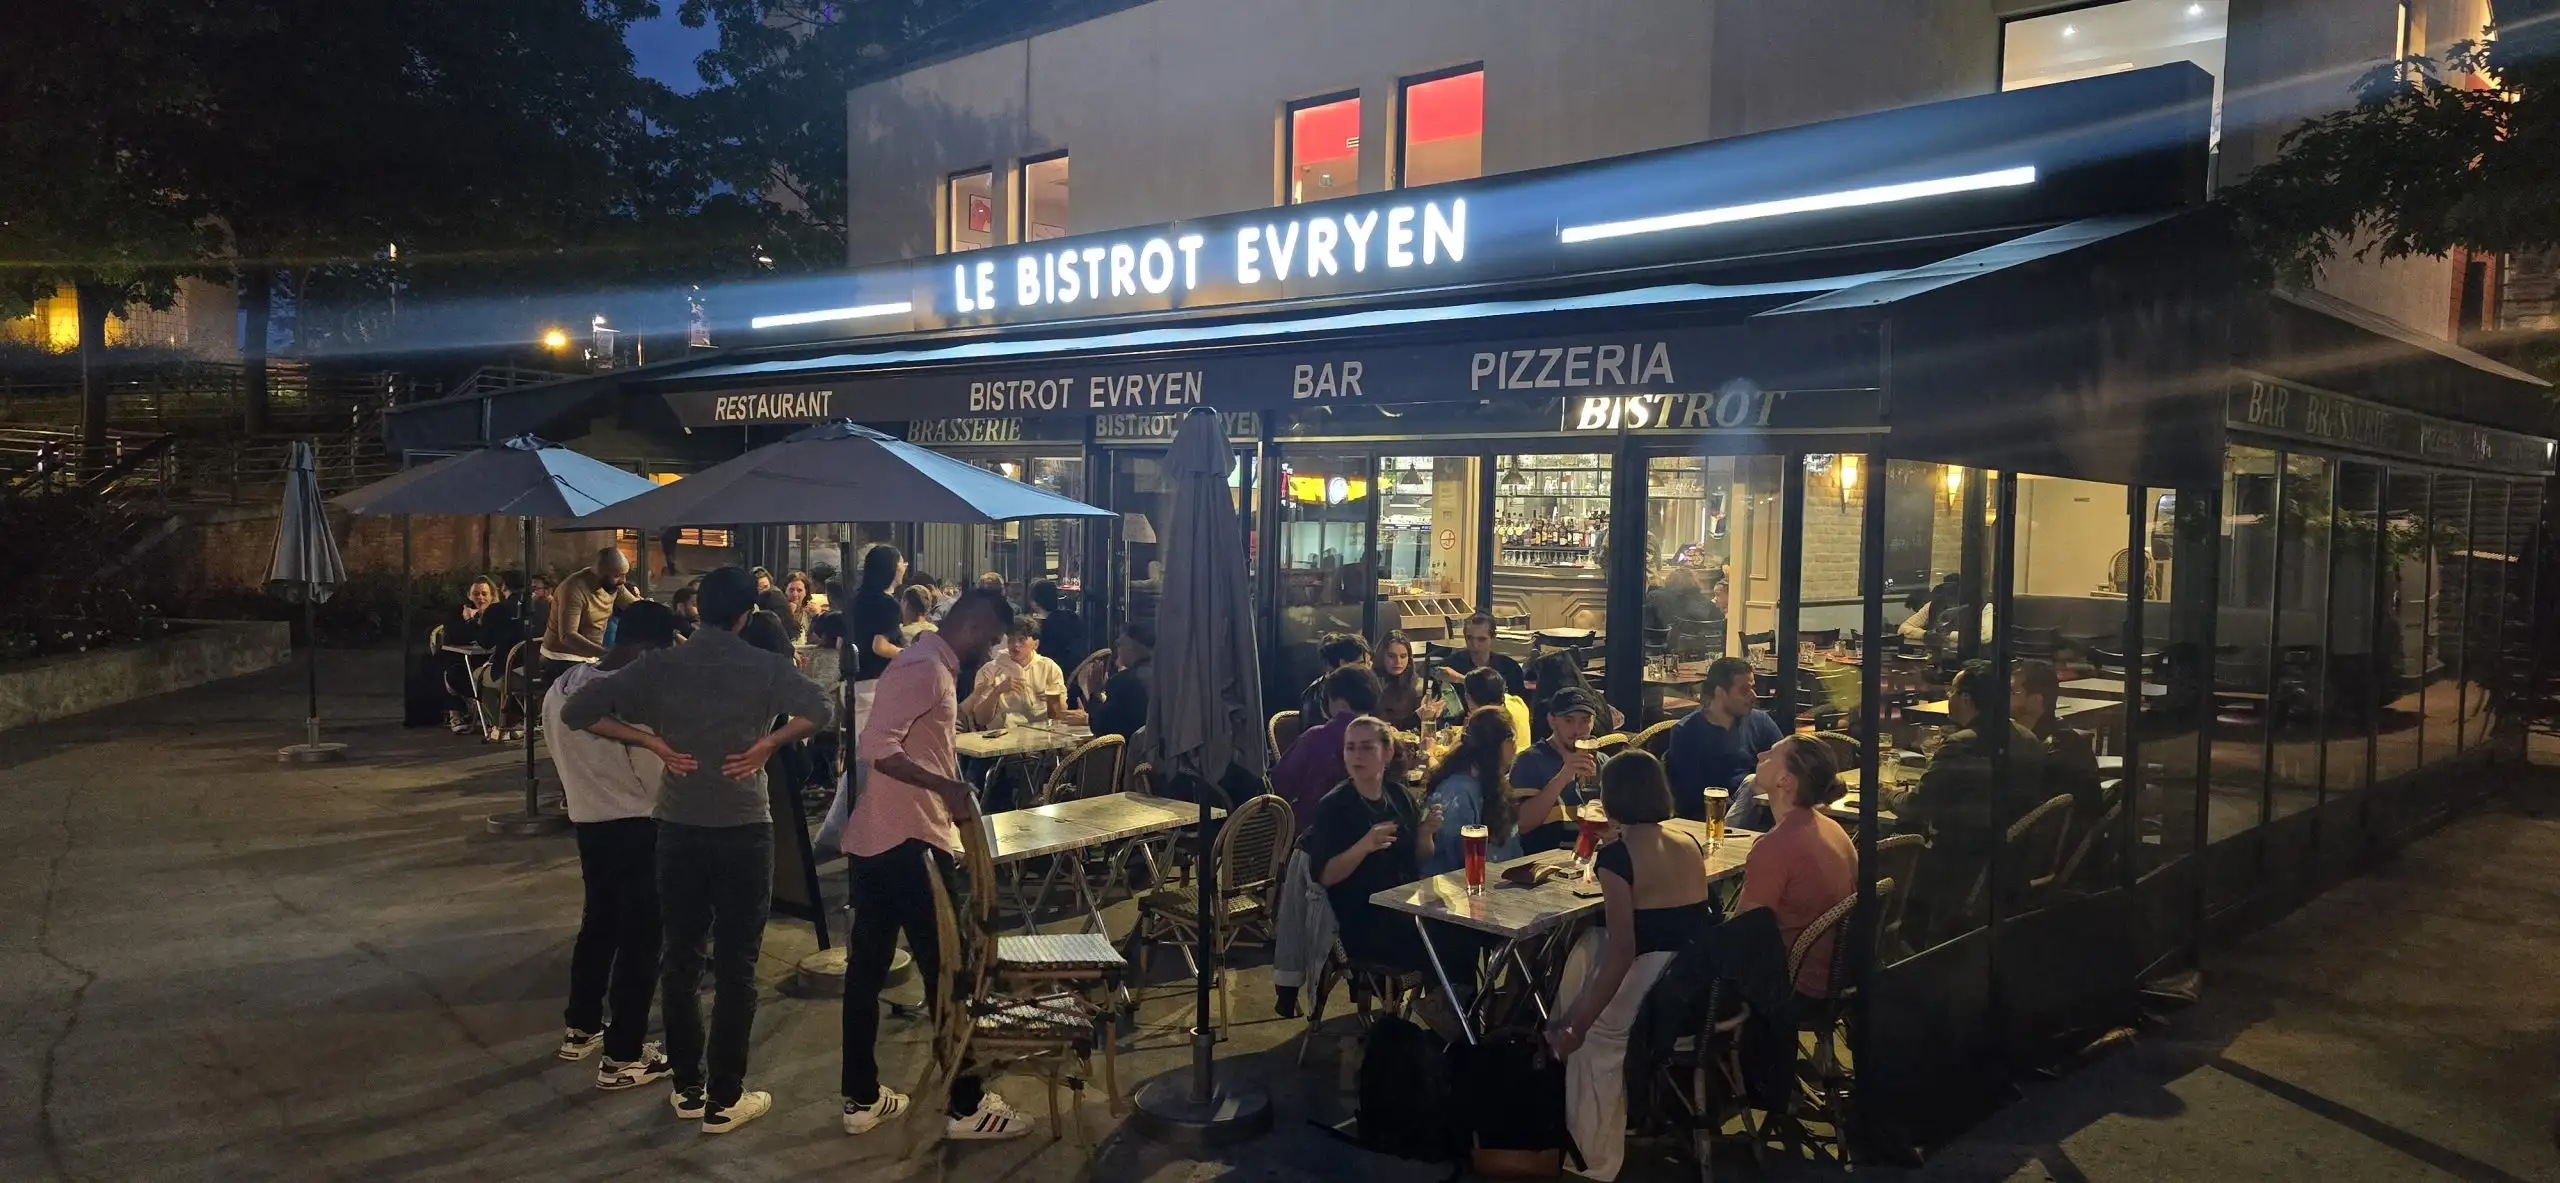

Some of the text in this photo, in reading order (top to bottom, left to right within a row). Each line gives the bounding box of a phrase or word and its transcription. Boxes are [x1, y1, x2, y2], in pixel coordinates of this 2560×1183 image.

[955, 198, 1466, 313] LE BISTROT EVRYEN
[1293, 361, 1363, 399] BAR
[1471, 341, 1674, 391] PIZZERIA
[715, 390, 833, 421] RESTAURANT
[969, 371, 1203, 411] BISTROT EVRYEN
[1576, 391, 1787, 430] BISTROT
[2247, 380, 2290, 428] BAR
[907, 416, 1023, 442] BRASSERIE
[1095, 412, 1177, 437] BISTROT
